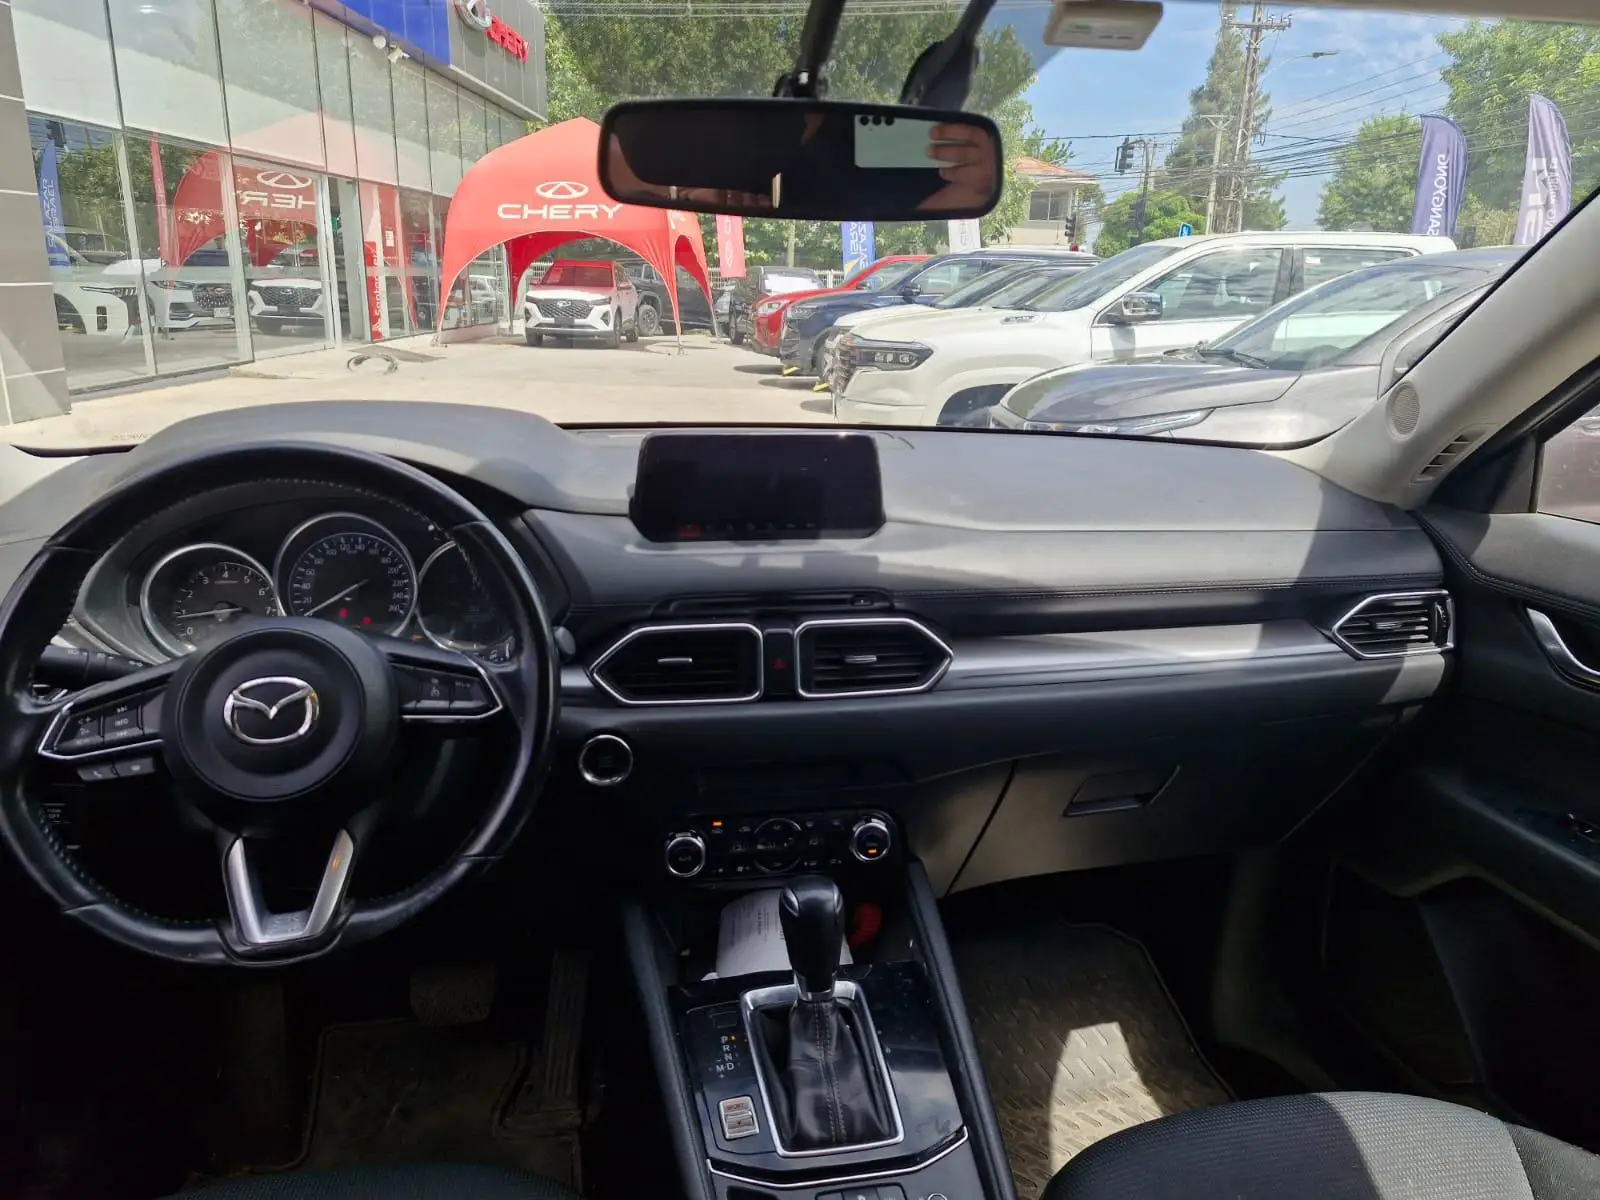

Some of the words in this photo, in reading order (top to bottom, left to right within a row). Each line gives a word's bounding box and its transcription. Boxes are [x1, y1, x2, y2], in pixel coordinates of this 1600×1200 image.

[497, 203, 624, 220] CHERY
[223, 570, 229, 578] 4
[203, 577, 209, 585] 3
[244, 575, 250, 584] 5
[187, 590, 193, 598] 2
[258, 588, 265, 596] 6
